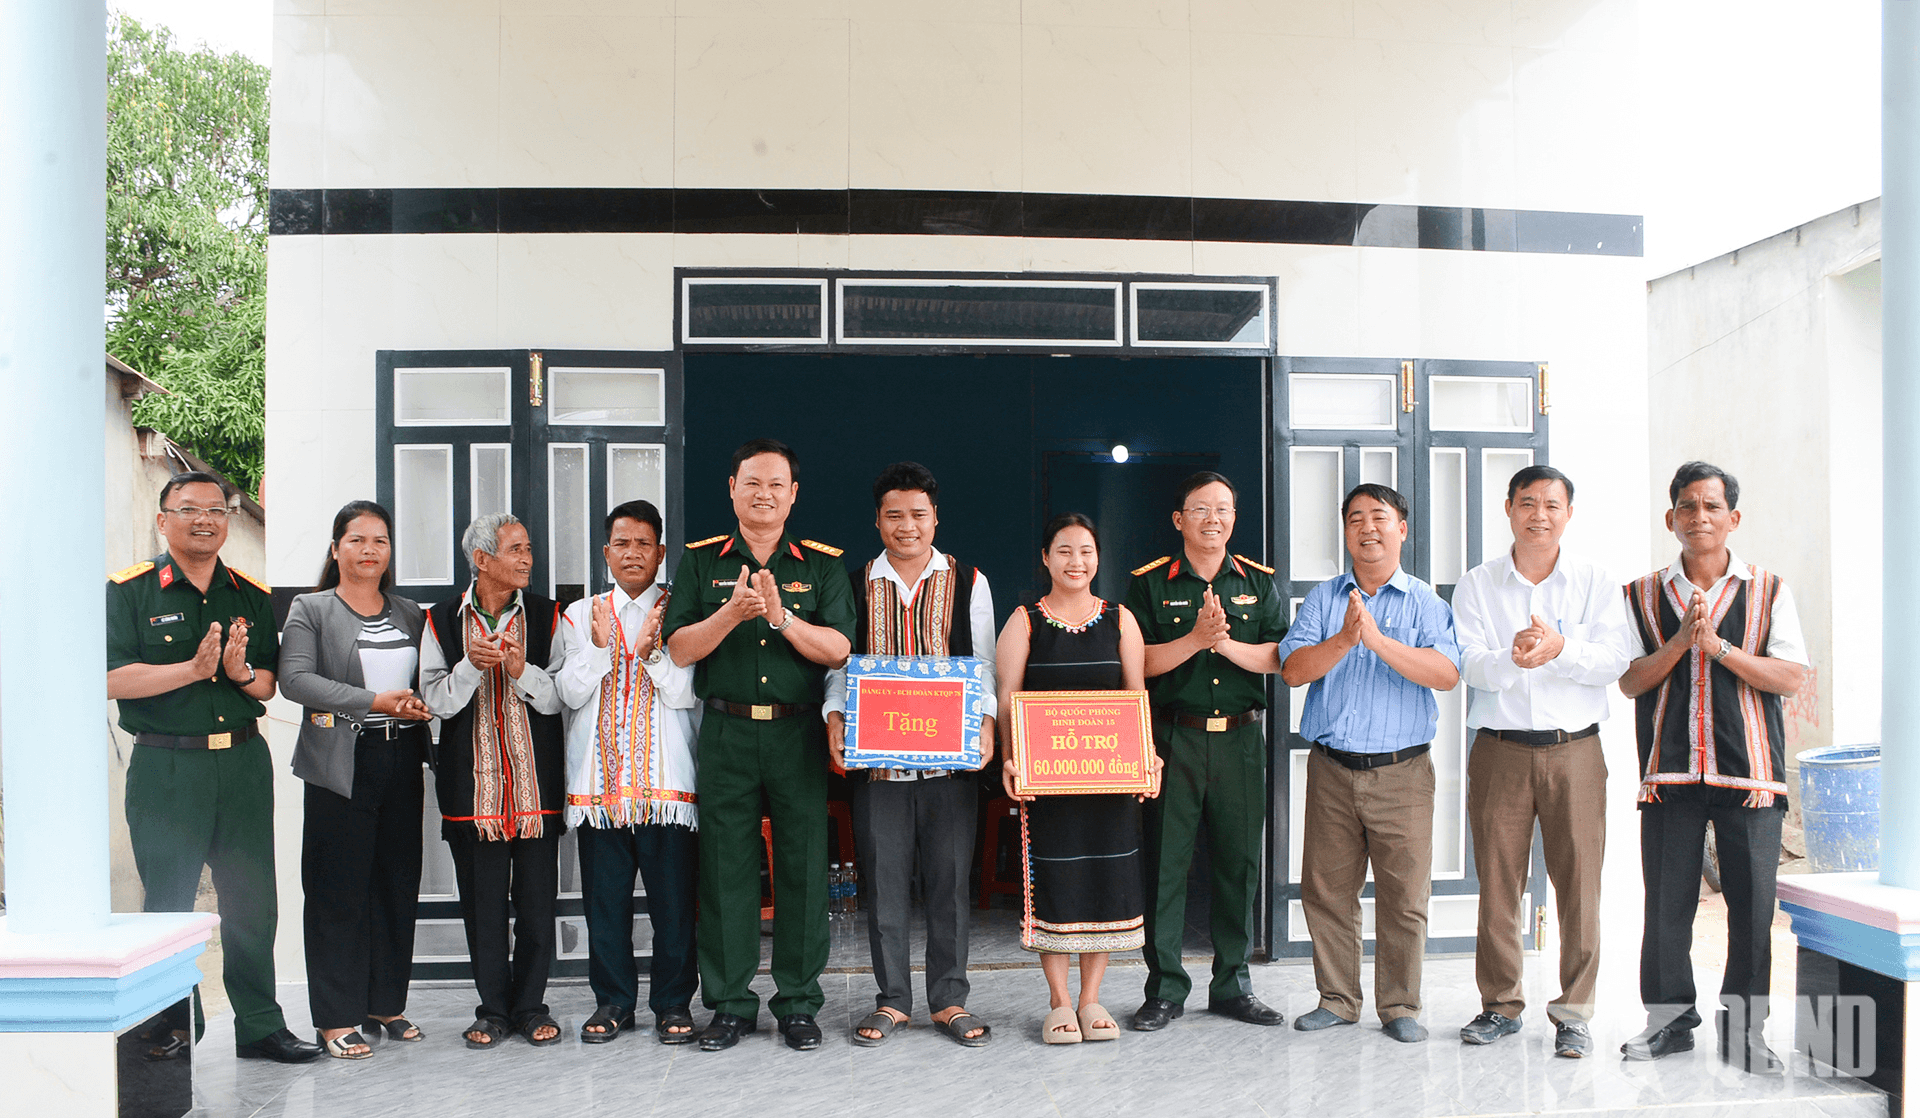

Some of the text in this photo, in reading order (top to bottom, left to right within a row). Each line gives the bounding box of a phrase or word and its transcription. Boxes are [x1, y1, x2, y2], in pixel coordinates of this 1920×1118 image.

[897, 688, 912, 696] BCH
[934, 689, 954, 698] KTQP
[1045, 706, 1121, 717] BỘ QUỐC PHÒNG
[883, 711, 938, 738] Tặng
[1052, 717, 1116, 726] BINH ĐOÀN 15
[1051, 728, 1119, 753] HỖ TRỢ
[1033, 753, 1140, 779] 60.000.000 đồng
